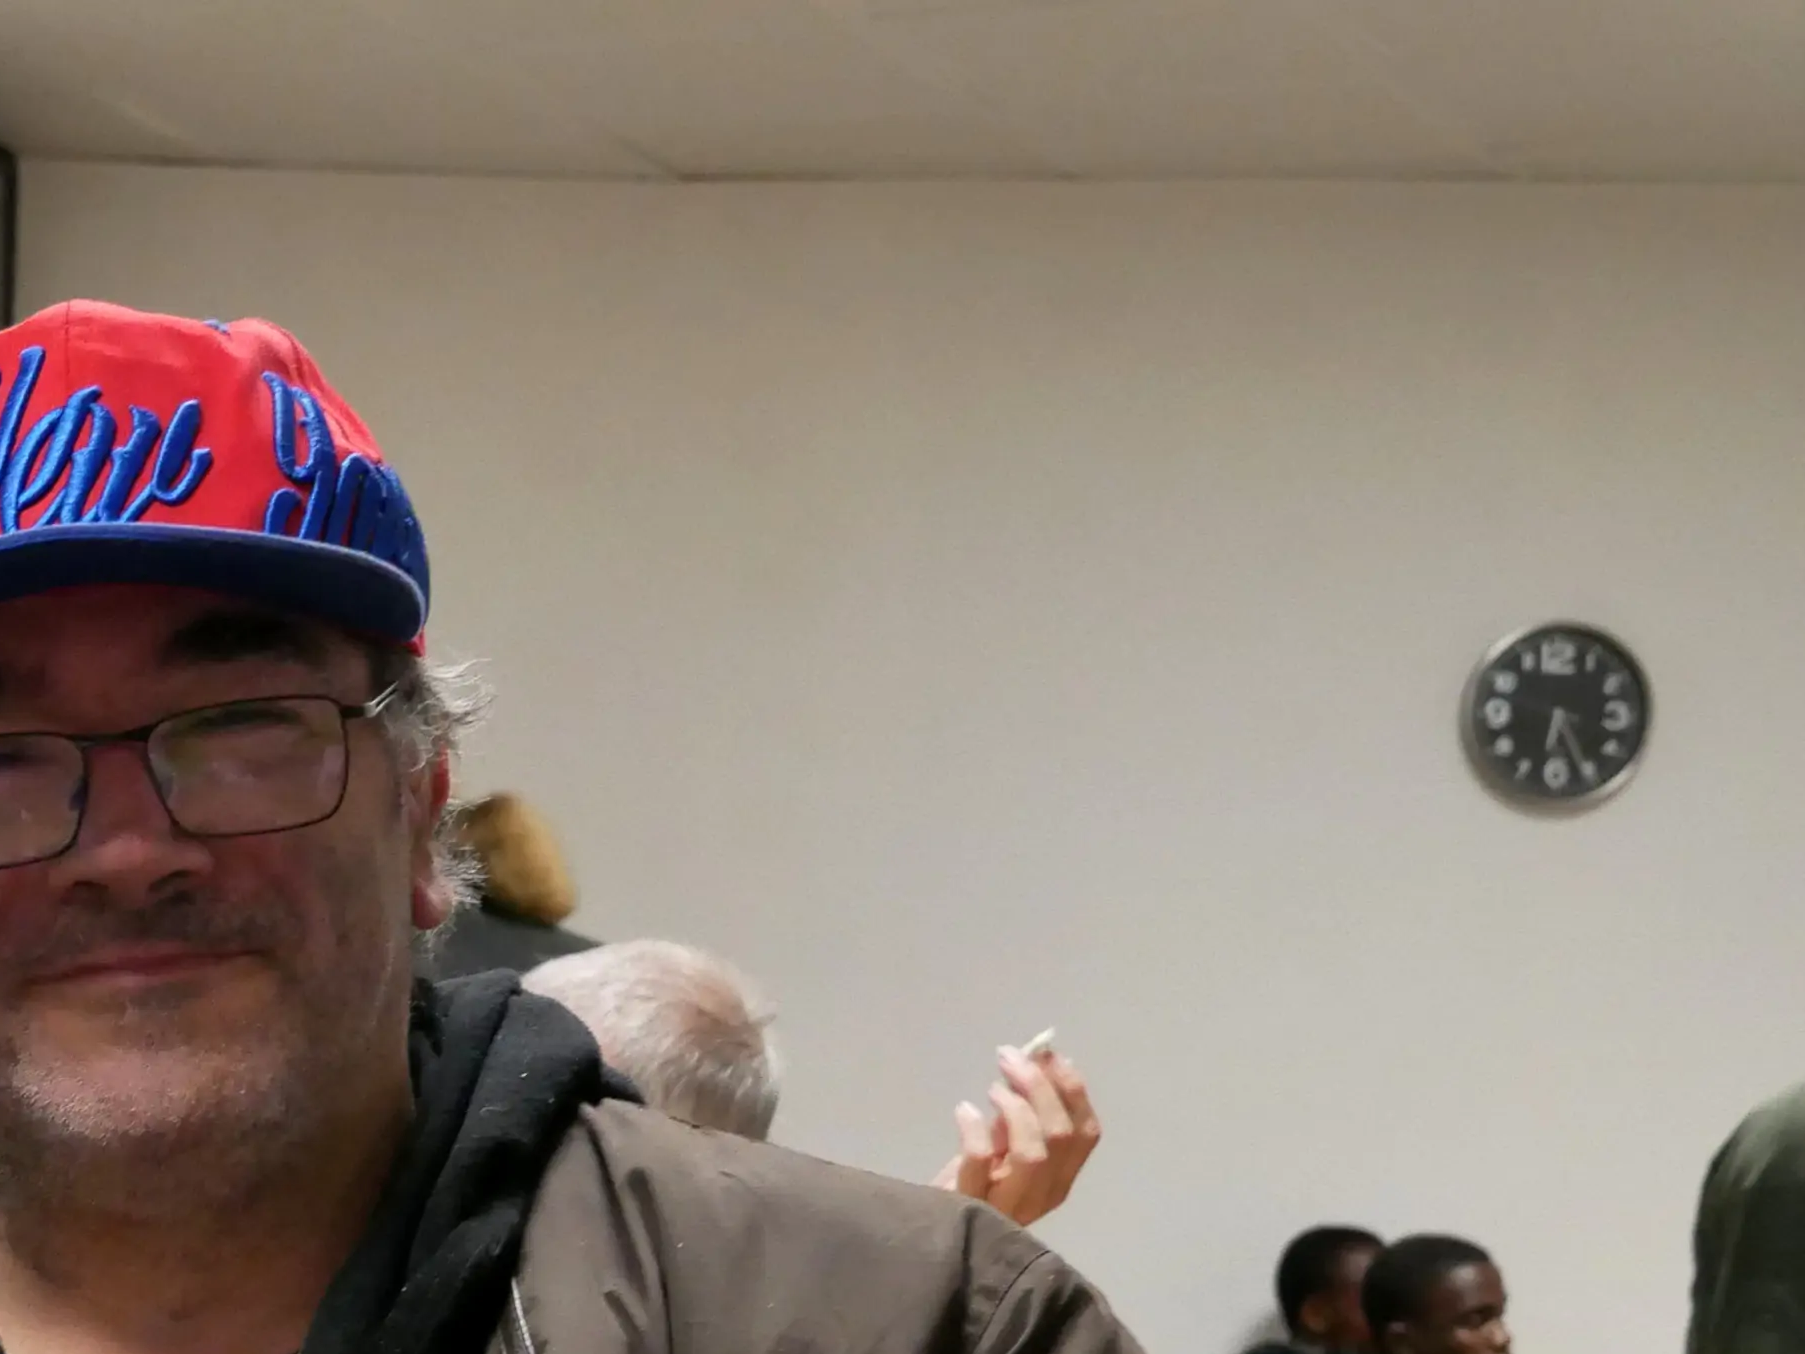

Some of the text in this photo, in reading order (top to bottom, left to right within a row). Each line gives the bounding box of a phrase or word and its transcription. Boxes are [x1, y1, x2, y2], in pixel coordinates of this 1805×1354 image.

[1541, 637, 1577, 676] 12
[1484, 696, 1513, 731] 9
[1600, 699, 1632, 732] 3
[1543, 756, 1571, 790] 6
